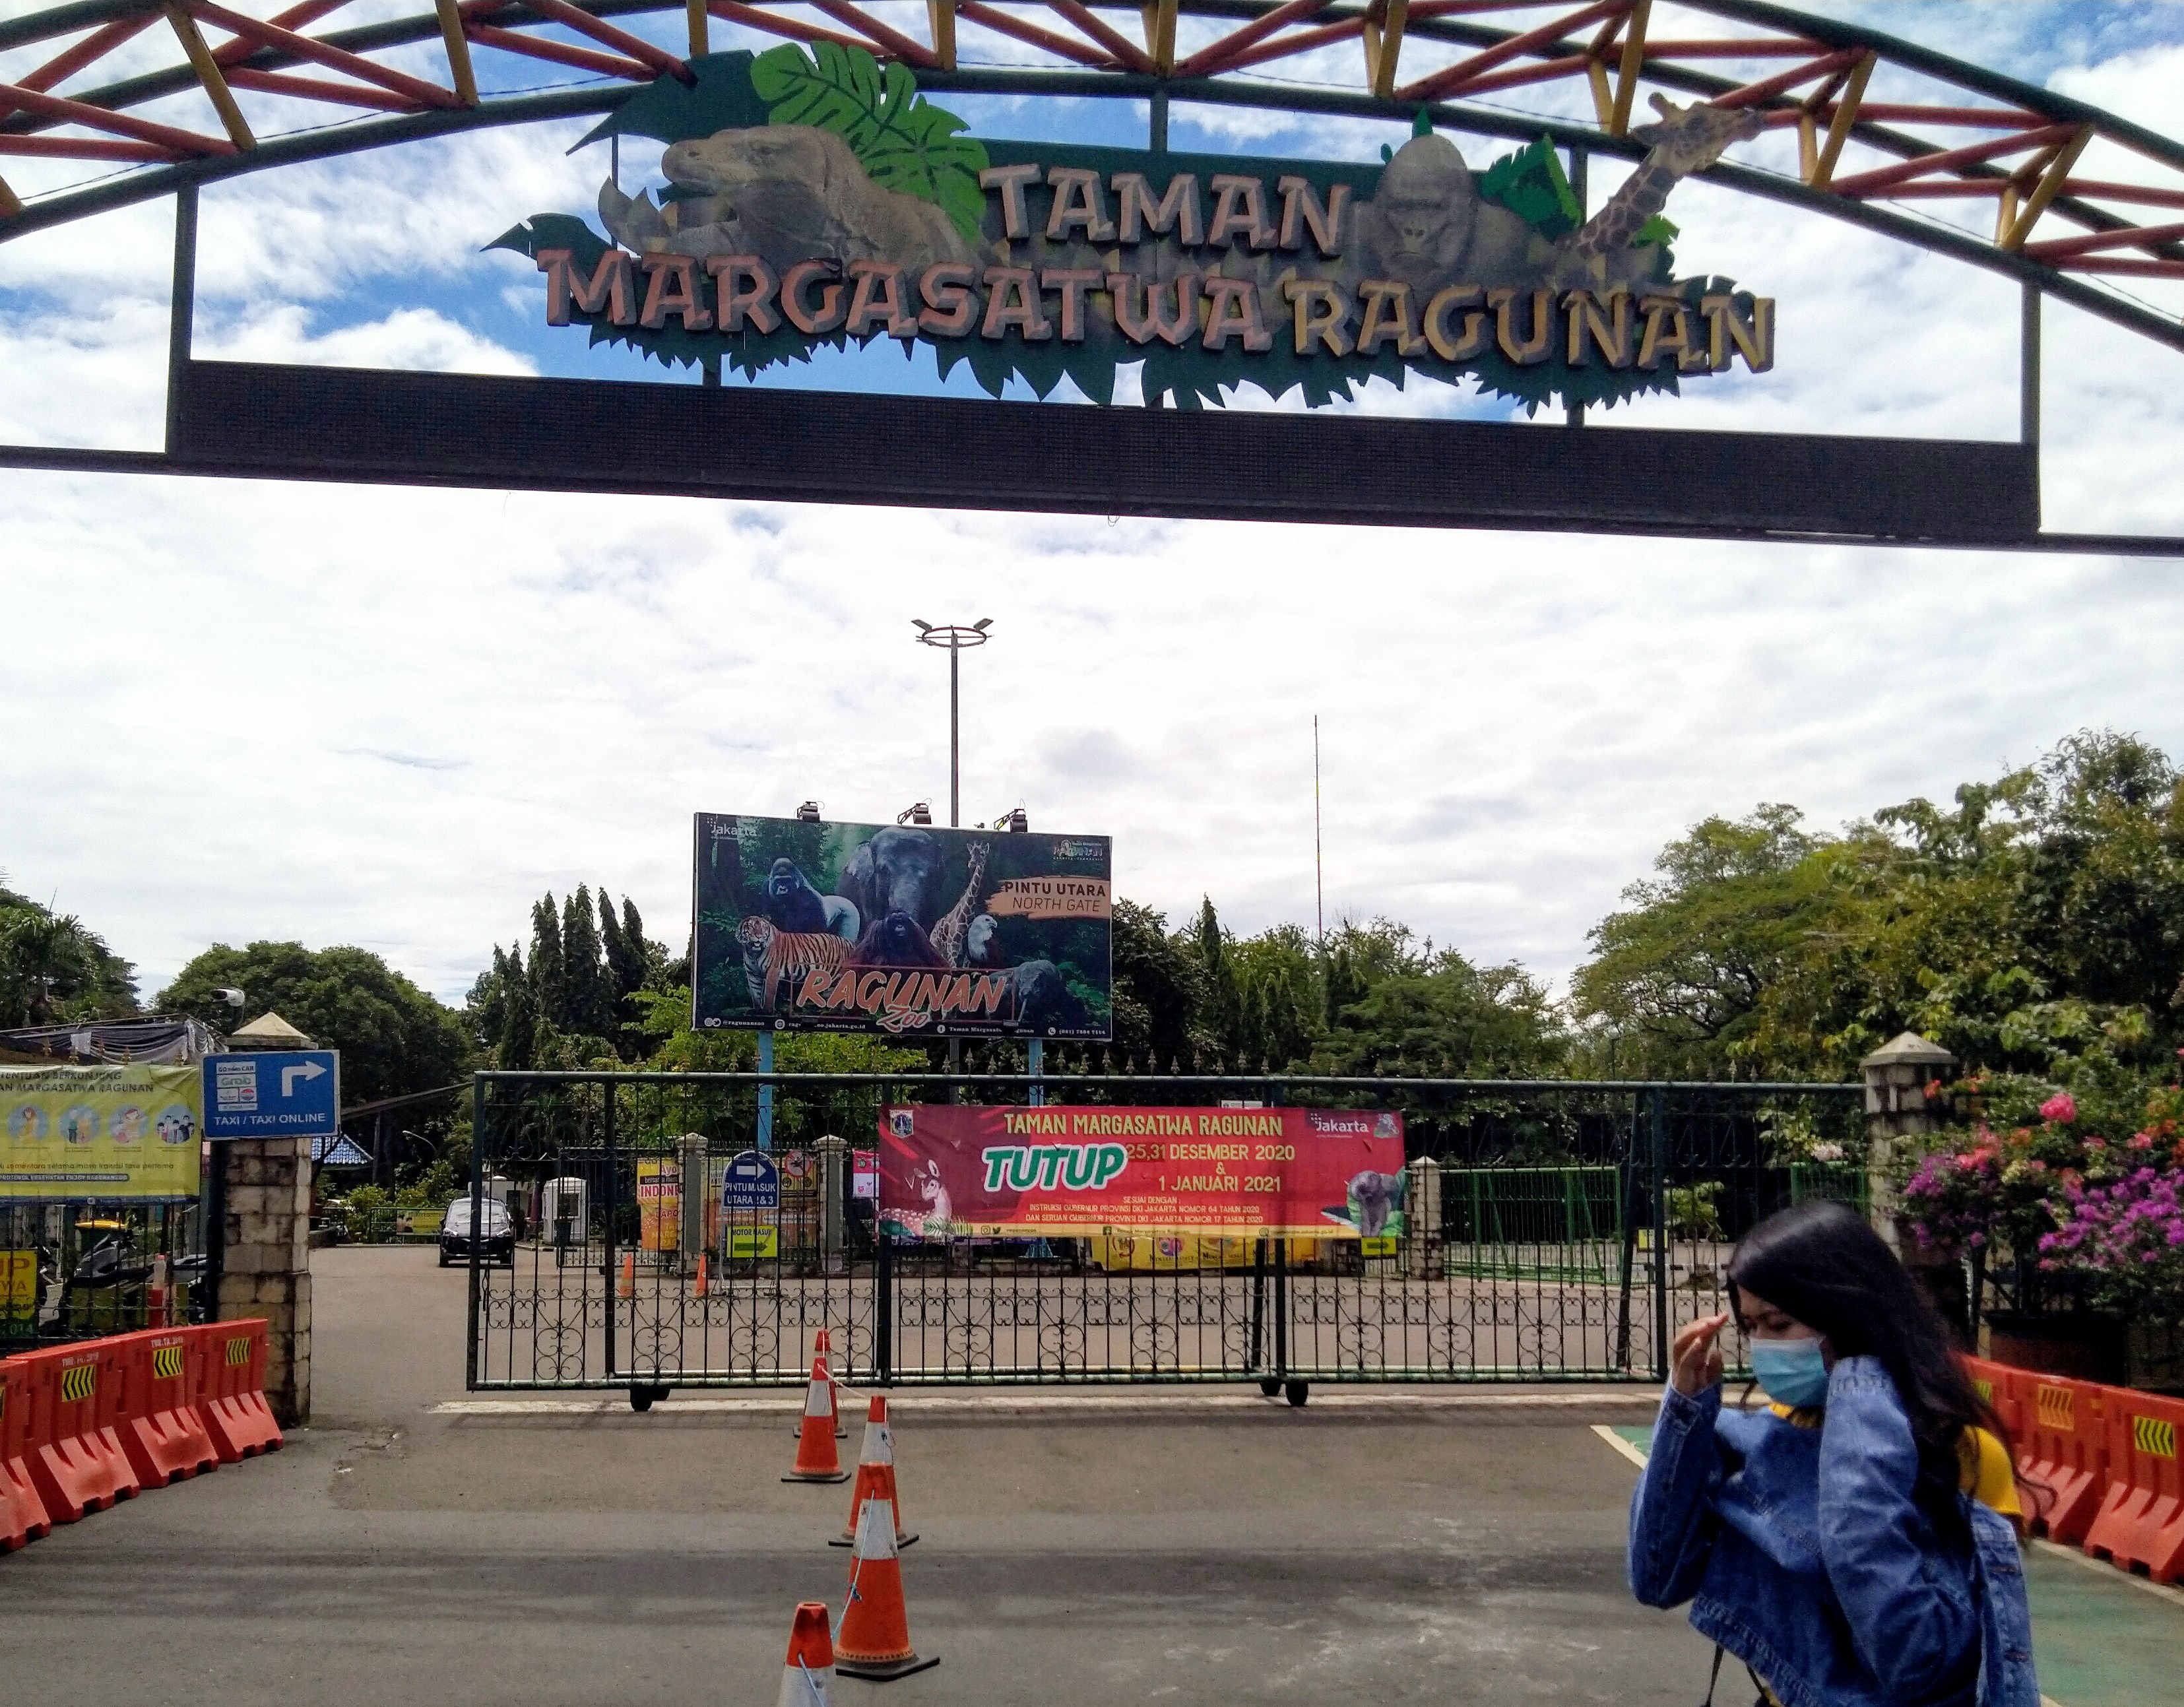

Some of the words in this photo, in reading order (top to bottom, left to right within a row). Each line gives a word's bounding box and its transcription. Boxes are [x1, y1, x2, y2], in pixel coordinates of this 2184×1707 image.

[979, 162, 1351, 257] TAMAN
[537, 248, 1273, 352] MARGASATWA
[1284, 278, 1776, 375] RAGUNAN
[1005, 882, 1051, 894] PINTU
[1057, 884, 1106, 897] UTARA
[1013, 897, 1061, 910] NORTH
[1066, 899, 1102, 912] GATE
[796, 969, 1007, 1014] RAGUNAN
[876, 1004, 931, 1033] Zoo
[99, 1083, 154, 1093] RAGUNAN
[214, 1116, 240, 1126] TAXI
[249, 1115, 276, 1125] TAXI
[278, 1113, 326, 1124] ONLINE
[1004, 1113, 1067, 1134] TAMAN
[1074, 1114, 1194, 1136] MARGASATWA
[1199, 1115, 1282, 1136] RAGUNAN
[1316, 1120, 1369, 1133] Jakarta
[1127, 1144, 1166, 1161] 25,31
[1170, 1144, 1249, 1161] DESEMBER
[1255, 1145, 1295, 1161] 2020
[982, 1143, 1128, 1191] TUTUP
[1215, 1161, 1226, 1175] &
[725, 1182, 748, 1192] PINTU
[1159, 1176, 1166, 1191] 1
[1171, 1176, 1238, 1192] JANUARI
[1244, 1176, 1281, 1192] 2021
[727, 1196, 754, 1205] UTARA
[759, 1196, 767, 1205] &
[768, 1196, 774, 1205] 3
